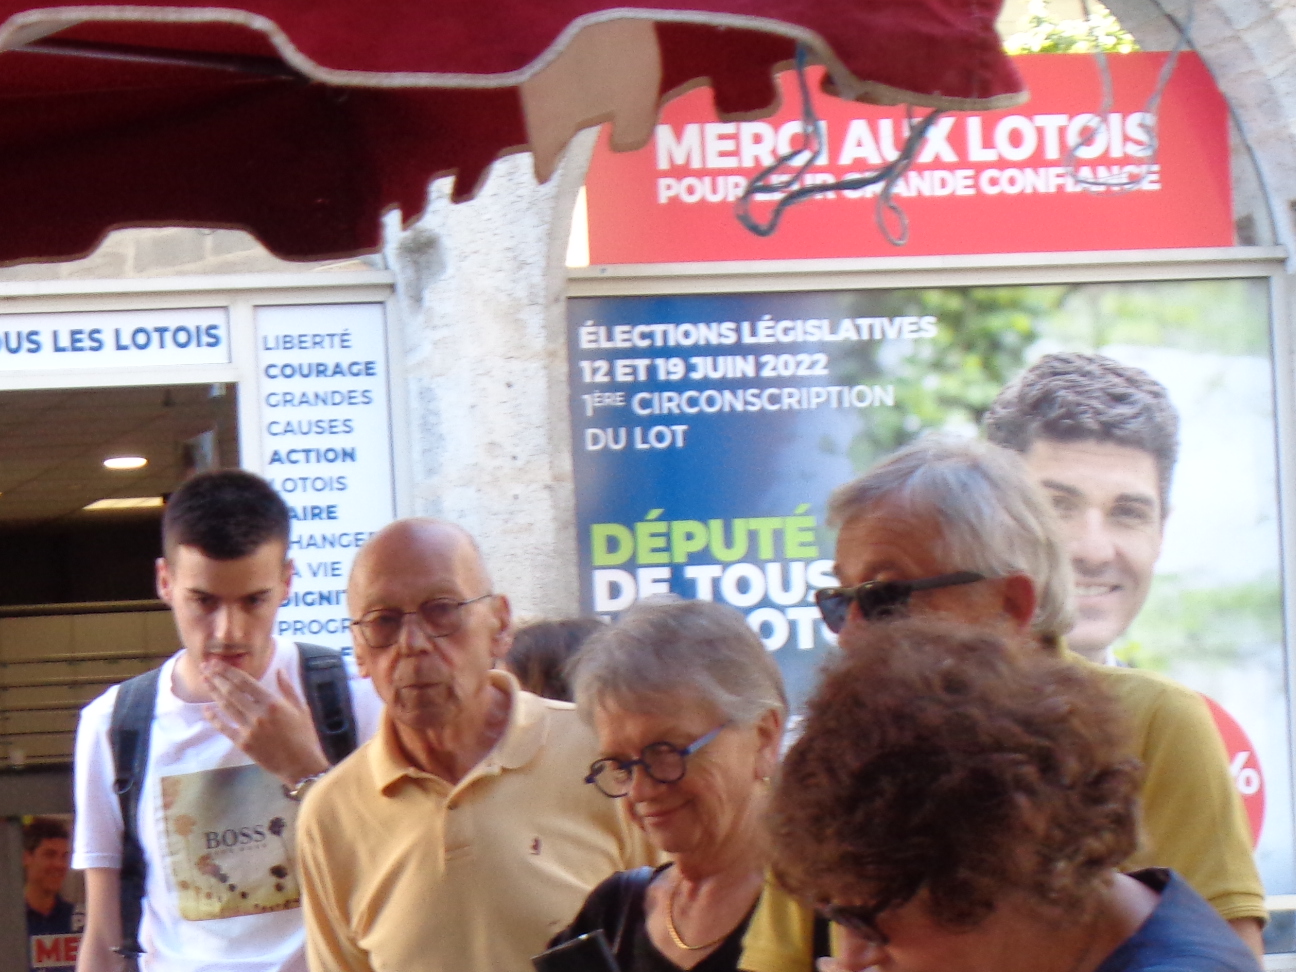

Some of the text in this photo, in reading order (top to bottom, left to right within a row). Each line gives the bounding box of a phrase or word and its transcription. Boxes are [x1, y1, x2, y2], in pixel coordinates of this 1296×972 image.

[656, 112, 1157, 170] MERCI AUX LOTOIS
[657, 175, 748, 204] POUR
[979, 164, 1162, 195] CONFIANCE
[53, 327, 104, 353] LES
[114, 324, 221, 351] LOTOIS
[263, 328, 352, 350] LIBERTÉ
[579, 315, 939, 349] ÉLECTIONS LÉGISLATIVES
[264, 360, 377, 379] COURAGE
[580, 353, 829, 382] 12 ET 19 JUIN 2022
[266, 389, 373, 408] GRANDES
[632, 384, 895, 416] CIRCONSCRIPTION
[267, 418, 354, 436] CAUSES
[585, 424, 689, 450] DU LOT
[268, 446, 357, 465] ACTION
[288, 504, 339, 521] AIRE
[590, 504, 819, 566] DÉPUTÉ
[306, 561, 343, 577] VIE
[205, 825, 266, 849] BOSS
